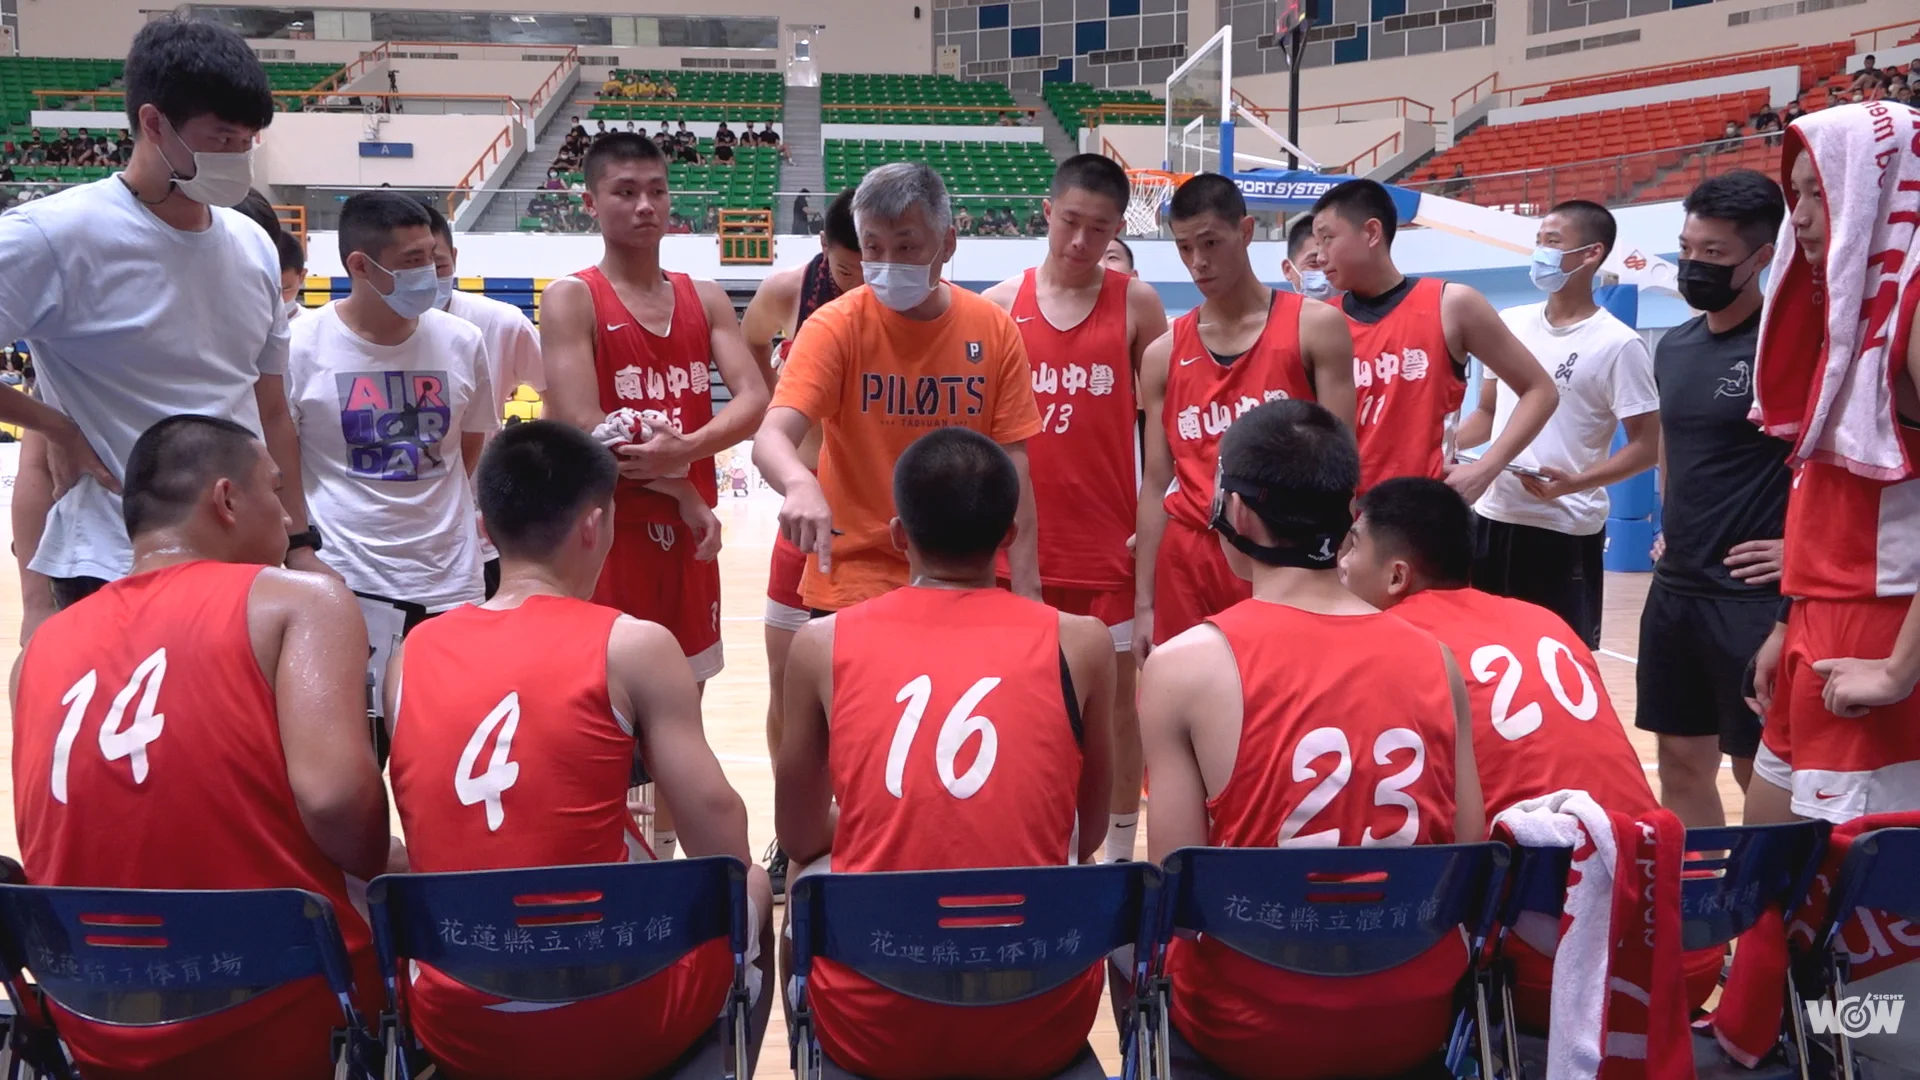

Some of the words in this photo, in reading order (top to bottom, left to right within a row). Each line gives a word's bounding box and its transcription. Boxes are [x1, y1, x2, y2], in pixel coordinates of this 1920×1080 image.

[381, 144, 390, 154] A
[1028, 362, 1115, 396] 山中學
[1042, 402, 1073, 434] 13
[1177, 389, 1290, 440] 南山中
[1361, 394, 1386, 426] 11
[51, 647, 167, 804] 14
[1469, 636, 1599, 741] 20
[454, 691, 520, 831] 4
[885, 674, 1002, 799] 16
[1277, 726, 1426, 847] 23
